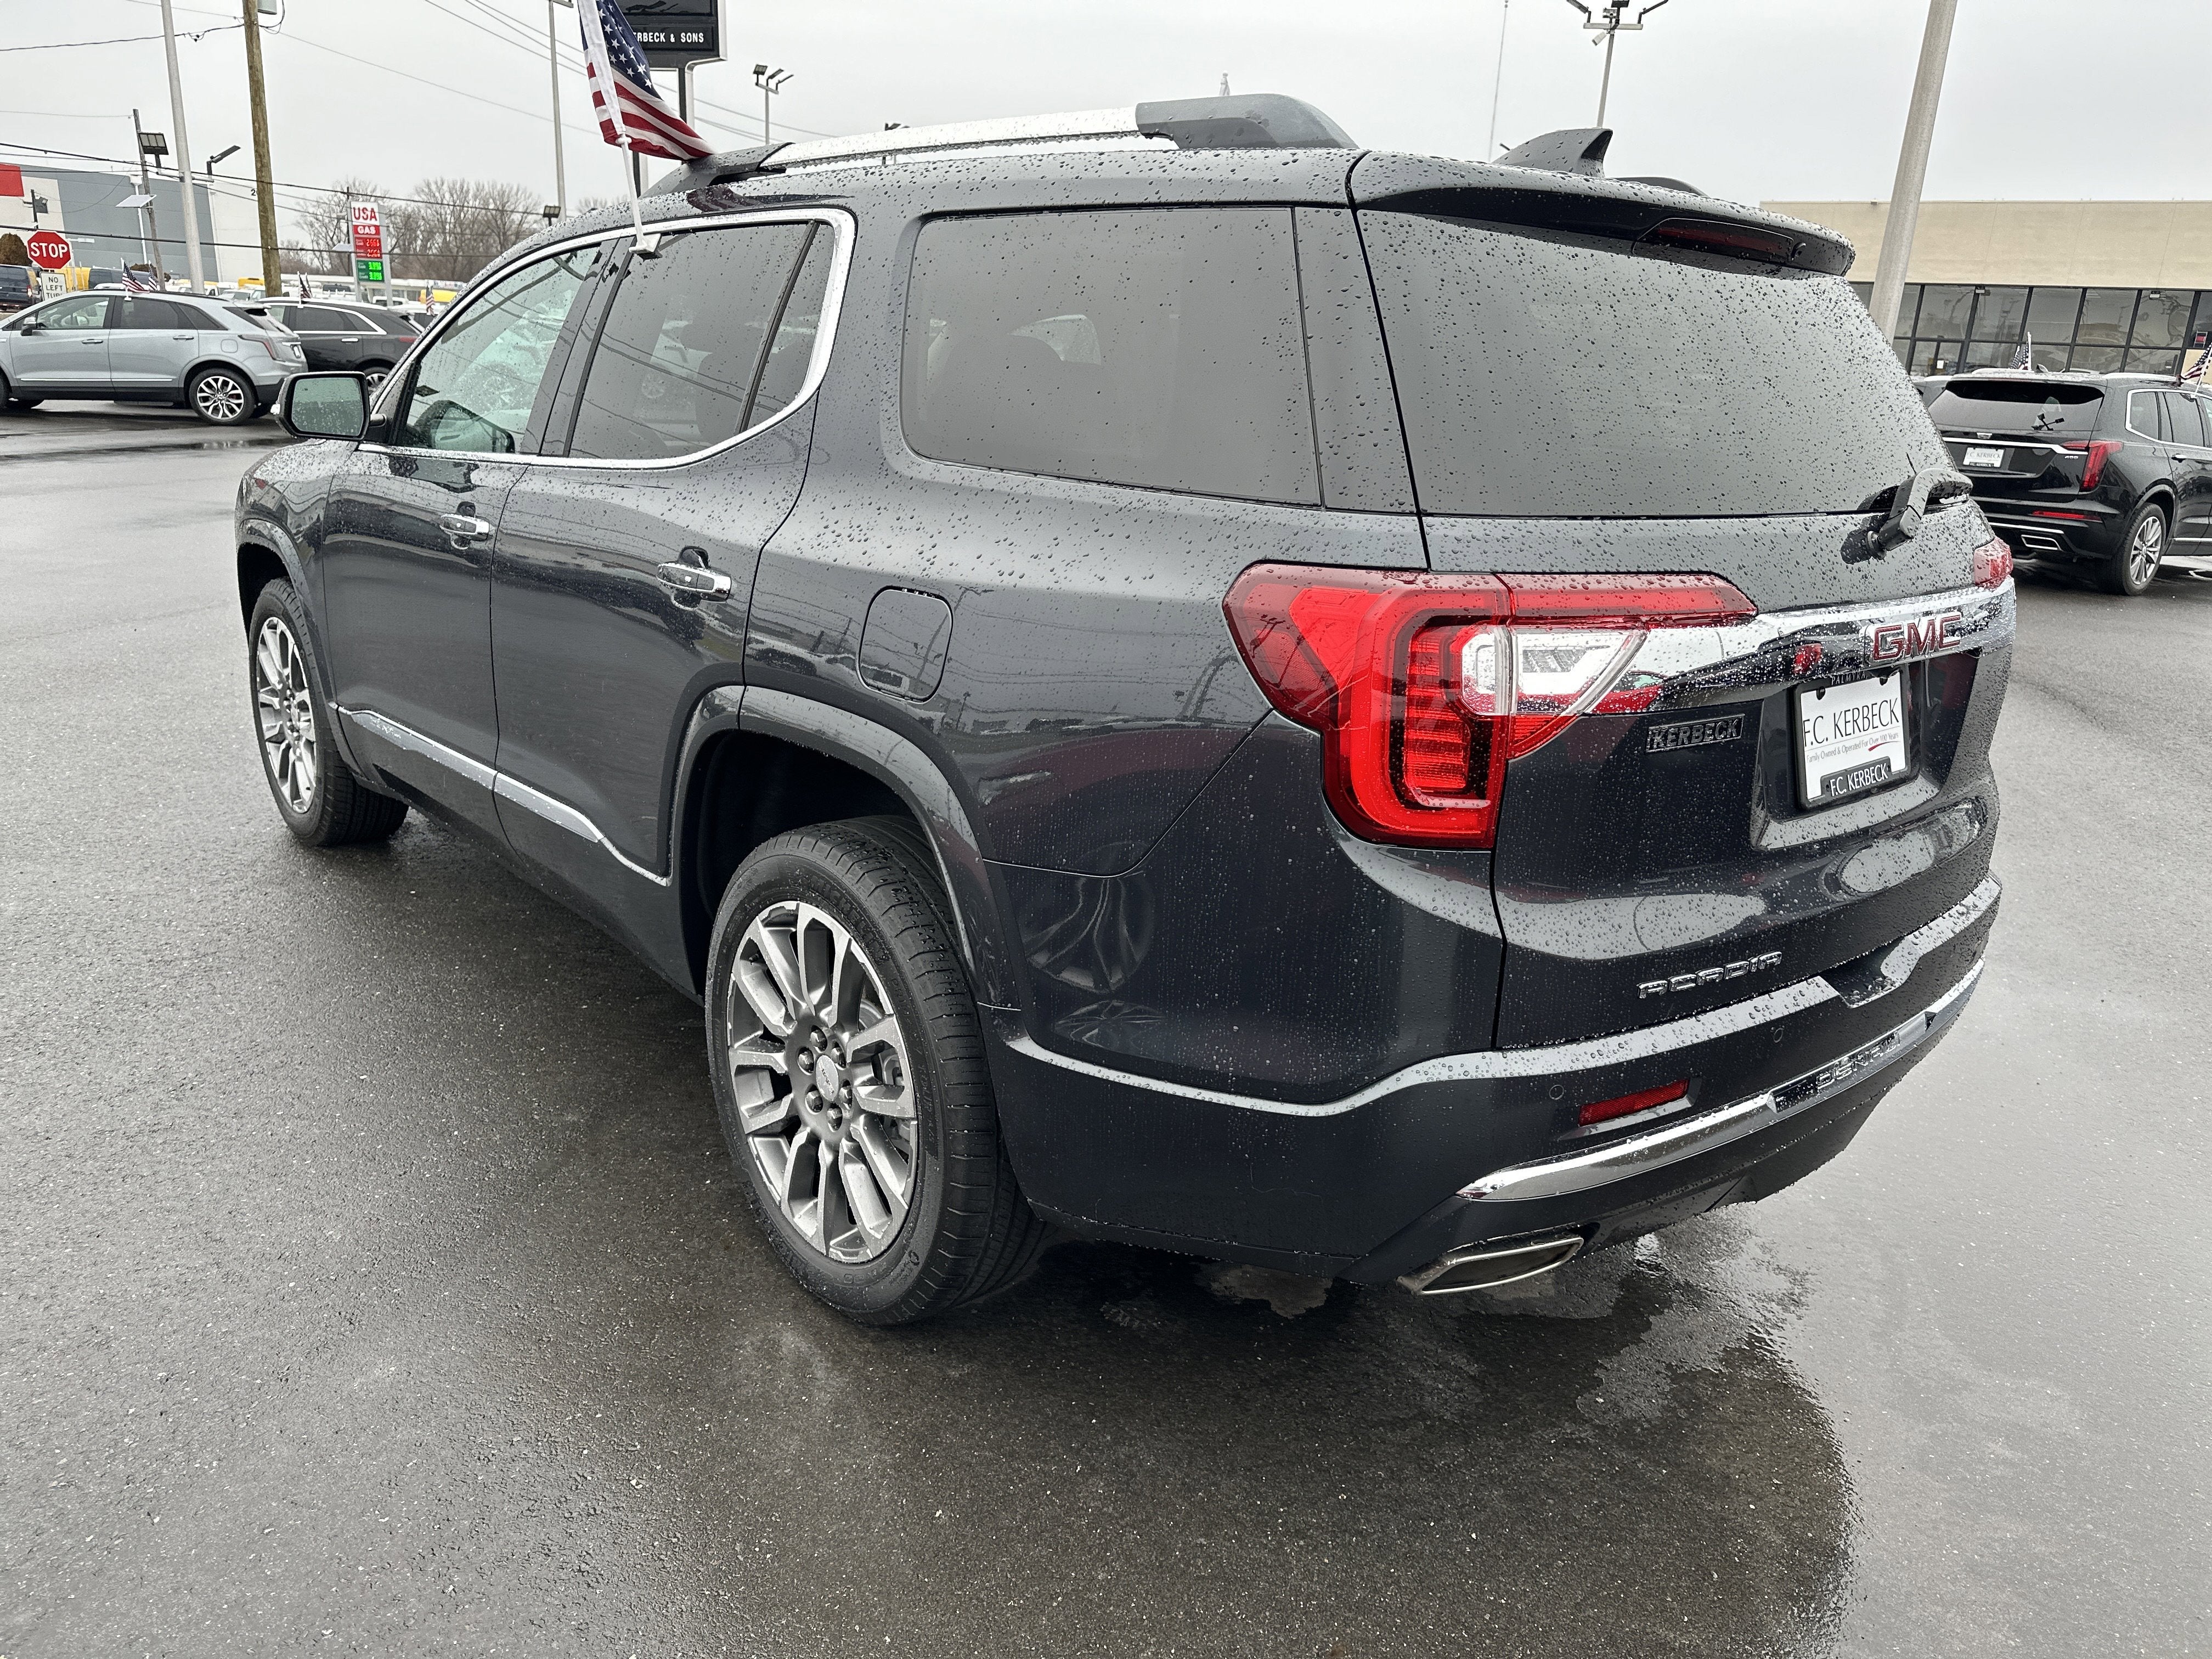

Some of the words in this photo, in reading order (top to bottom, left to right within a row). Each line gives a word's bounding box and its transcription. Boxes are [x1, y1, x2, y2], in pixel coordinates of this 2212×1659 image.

[633, 32, 665, 42] RBECK
[670, 33, 675, 42] &
[681, 32, 704, 43] SONS
[353, 207, 377, 221] USA
[358, 225, 376, 234] GAS
[30, 242, 67, 258] STOP
[1872, 611, 1962, 661] GMC
[1652, 719, 1739, 749] KERBECK
[1803, 716, 1829, 747] F.C.
[1833, 698, 1899, 739] KERBECK
[1807, 752, 1820, 763] Family
[1820, 748, 1836, 759] Owned
[1842, 742, 1861, 754] Operated
[1869, 737, 1879, 746] Over
[1888, 732, 1899, 740] Years
[1830, 776, 1847, 797] F.C.
[1847, 763, 1888, 791] KERBECK
[1637, 951, 1782, 998] ACADIA
[1816, 1031, 1900, 1090] DENALI
